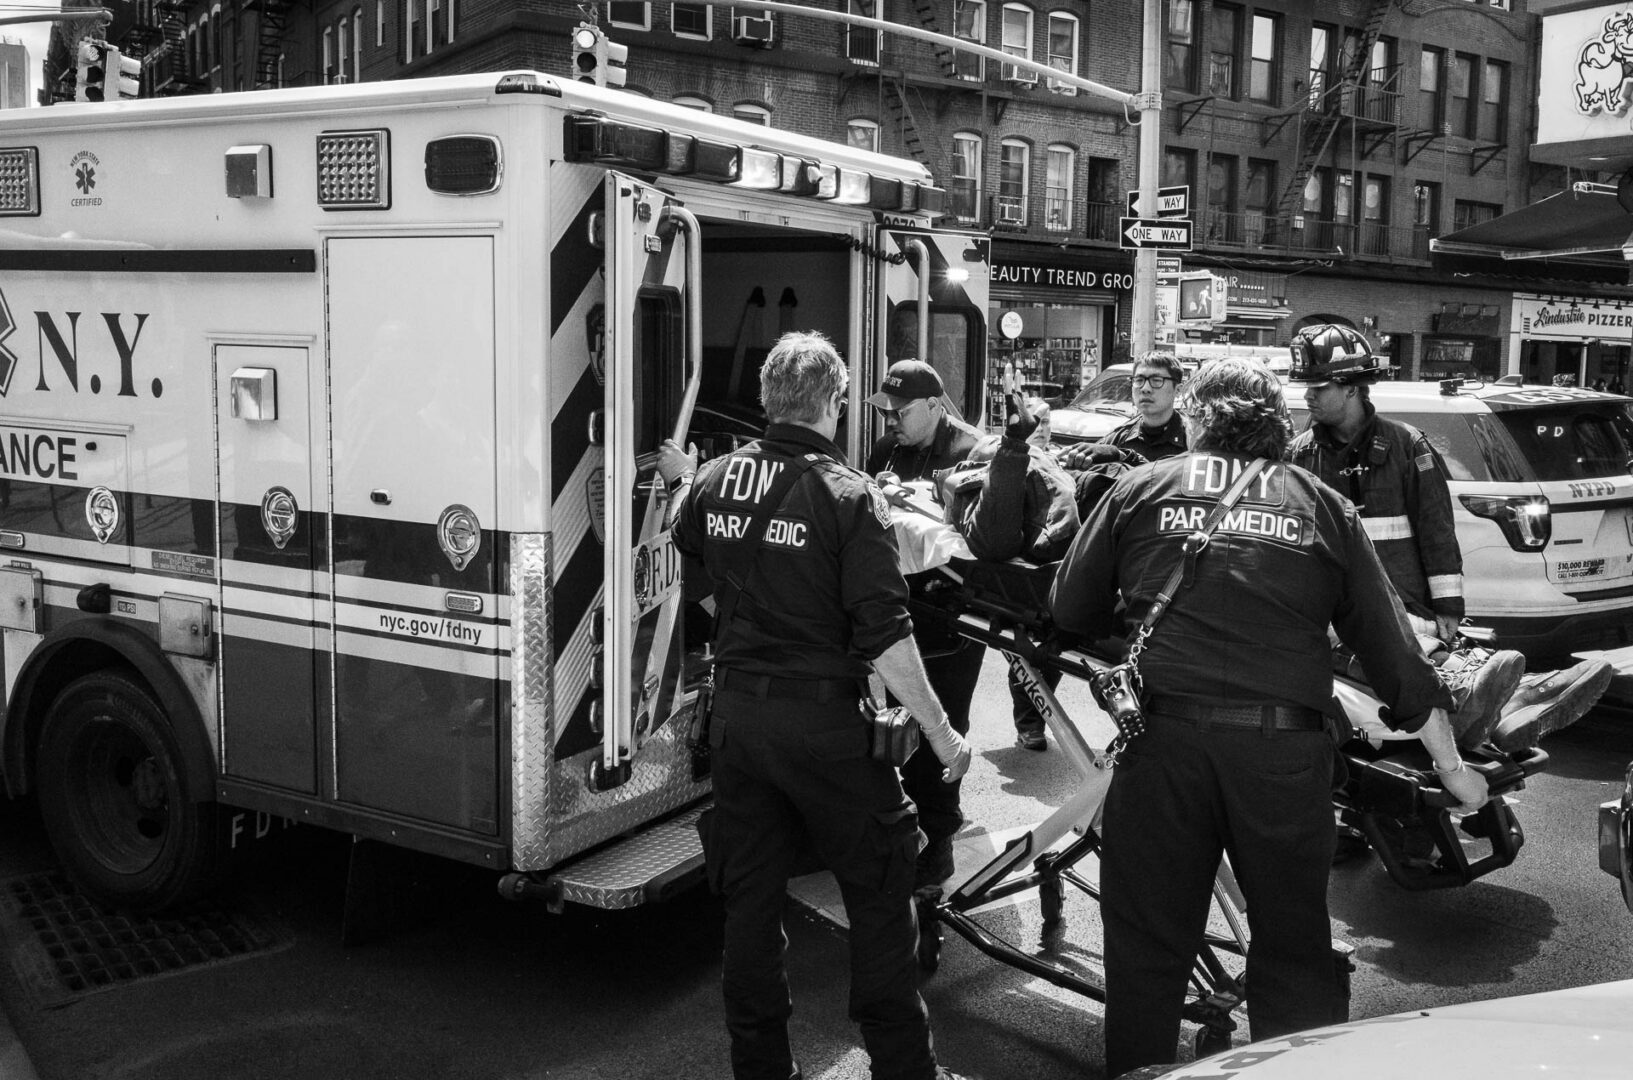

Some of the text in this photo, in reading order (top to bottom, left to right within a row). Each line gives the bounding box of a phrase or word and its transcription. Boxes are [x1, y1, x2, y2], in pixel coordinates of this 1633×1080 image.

[71, 197, 102, 207] CERTIFIED
[1164, 197, 1181, 209] WAY
[1132, 227, 1182, 241] ONE WAY
[990, 265, 1133, 290] EAUTY TREND GRO
[1224, 276, 1239, 288] AIR
[1588, 313, 1632, 327] PIZZER
[34, 311, 163, 398] N.Y.
[719, 456, 784, 504] FDN
[1568, 481, 1615, 498] NYPD
[707, 512, 807, 547] PAREDIC
[1558, 561, 1582, 572] $10,000
[380, 614, 482, 645] nyc.gov/fdny
